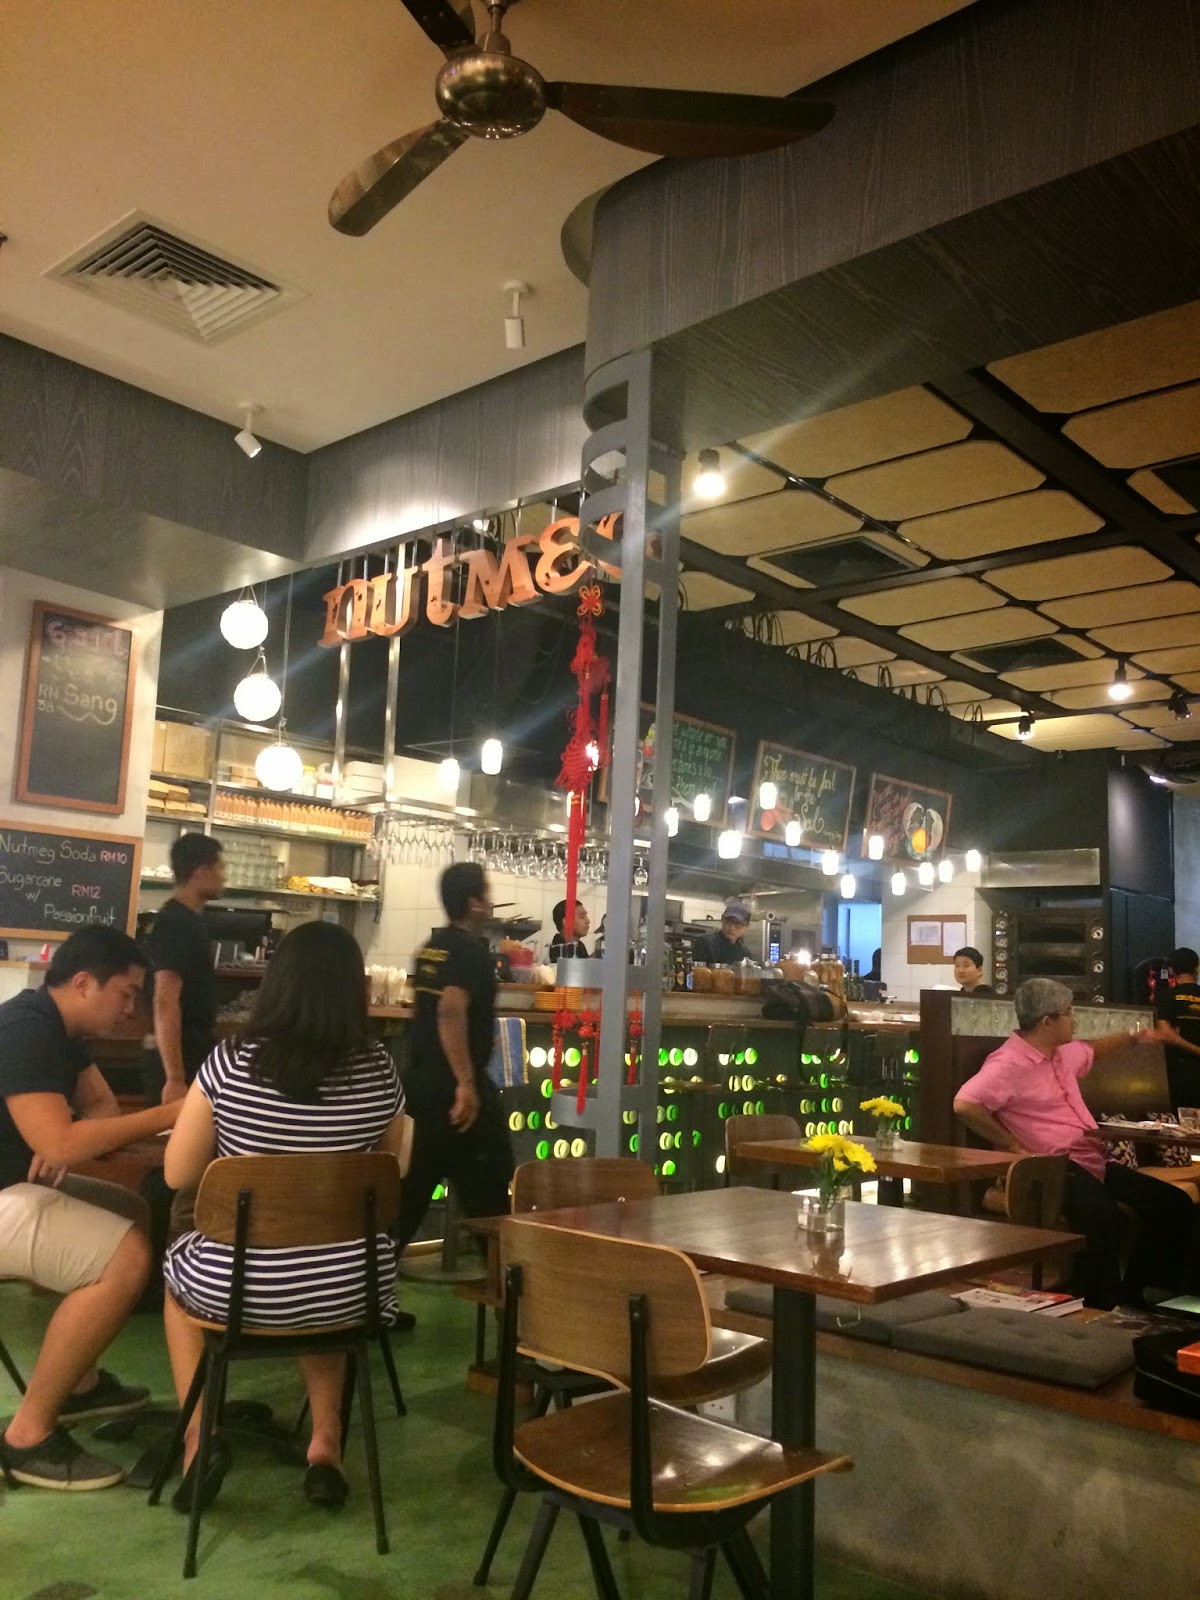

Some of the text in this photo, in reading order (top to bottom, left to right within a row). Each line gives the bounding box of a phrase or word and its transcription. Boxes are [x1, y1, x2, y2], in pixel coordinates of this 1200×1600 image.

[62, 683, 118, 725] Sang
[0, 833, 128, 865] Nutmeg Soda RM10
[0, 865, 63, 891] Sugarcane
[25, 888, 41, 902] w/
[71, 884, 101, 899] RM12
[44, 903, 116, 927] Passionfruit
